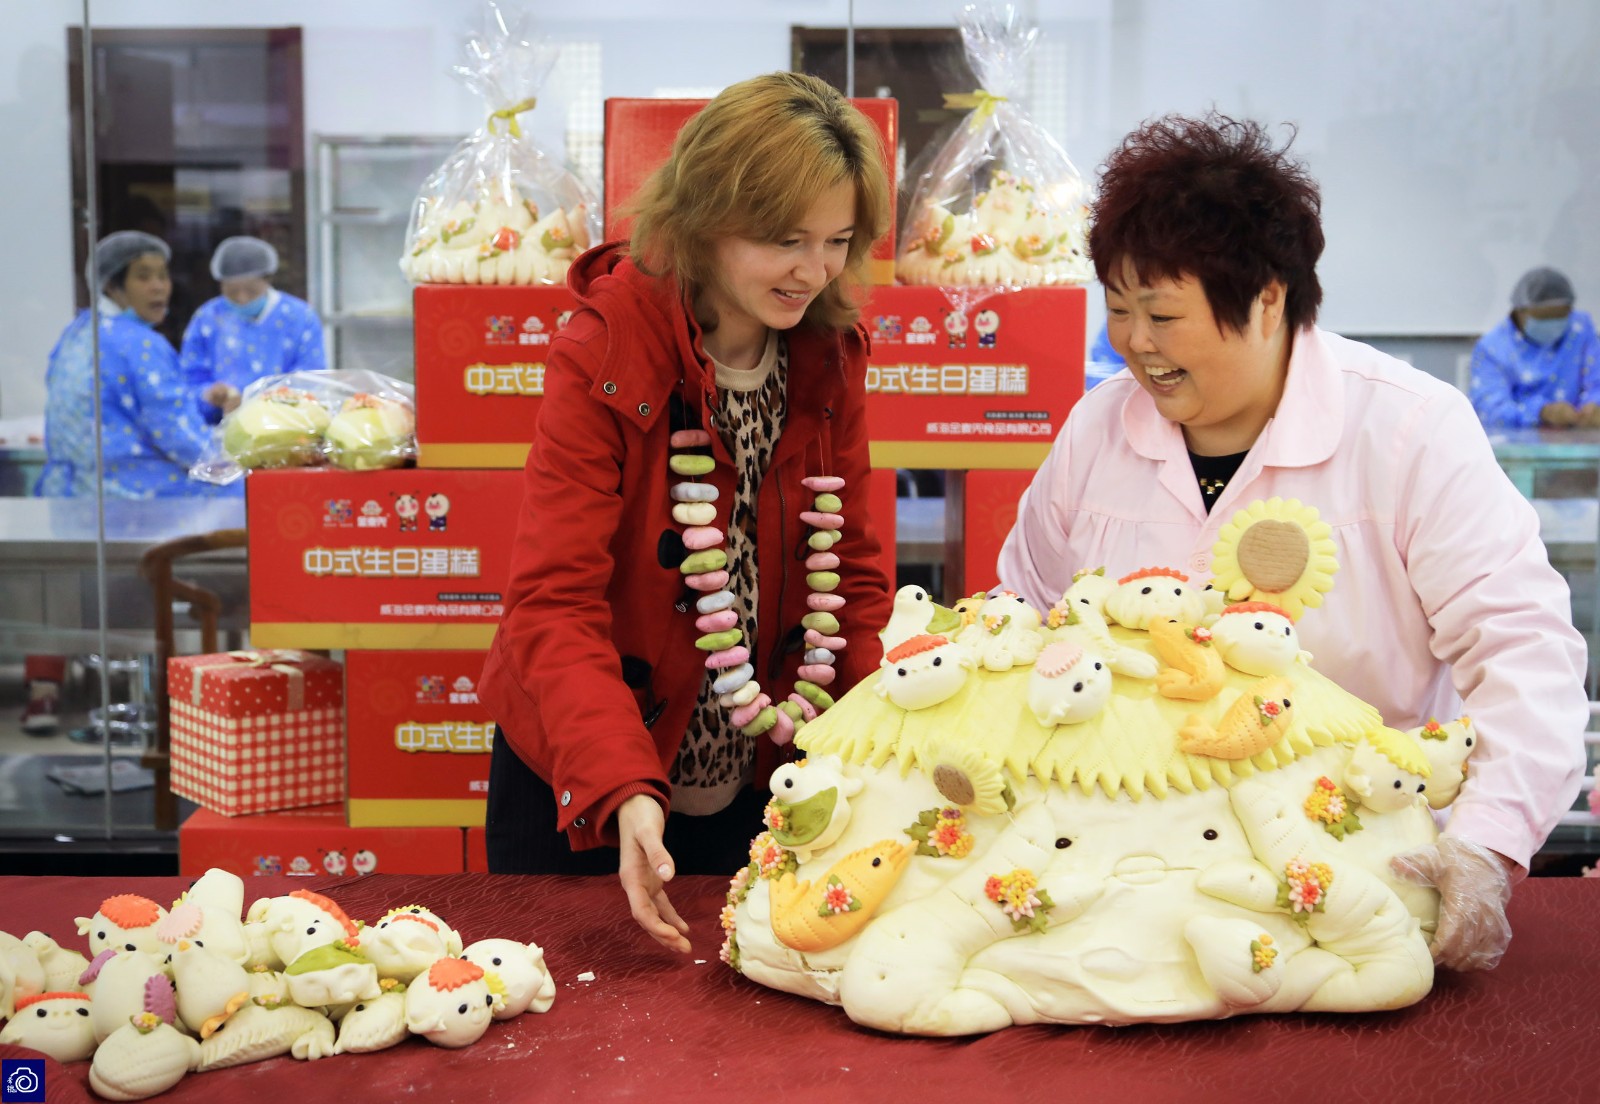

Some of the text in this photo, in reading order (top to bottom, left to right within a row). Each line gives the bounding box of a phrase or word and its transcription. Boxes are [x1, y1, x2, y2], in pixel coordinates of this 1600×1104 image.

[465, 365, 546, 394] 中式生
[304, 547, 479, 576] 中式生日蛋糕
